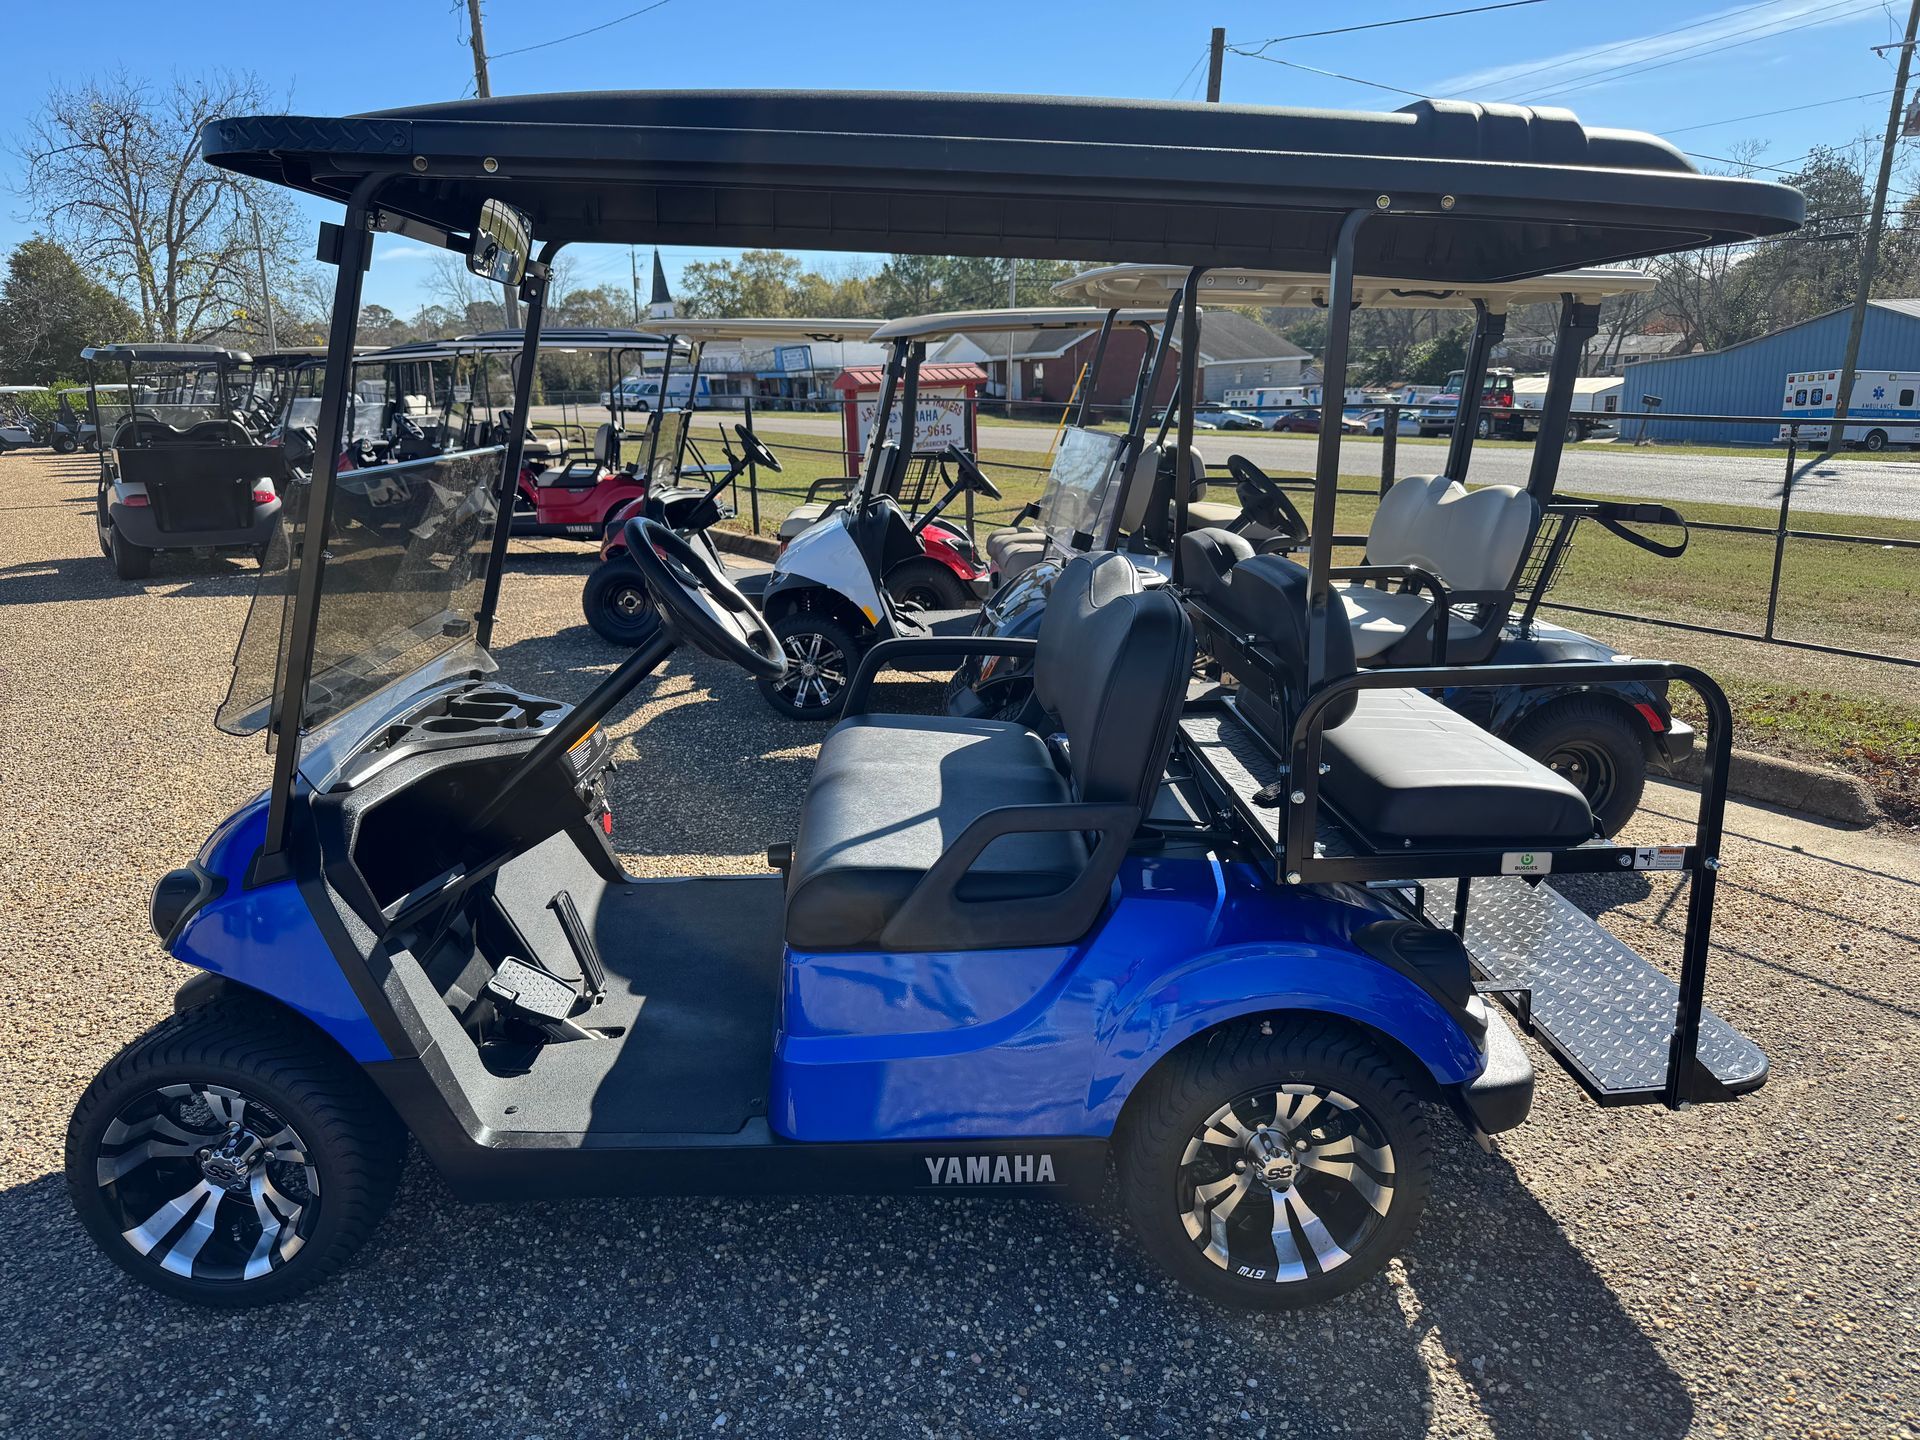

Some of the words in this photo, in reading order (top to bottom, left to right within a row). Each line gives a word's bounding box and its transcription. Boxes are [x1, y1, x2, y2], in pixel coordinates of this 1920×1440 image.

[566, 525, 593, 533] YAMAHA
[250, 1101, 278, 1119] GTW
[924, 1154, 1056, 1184] YAMAHA
[1268, 1164, 1293, 1180] SS
[1236, 1265, 1266, 1280] GTW
